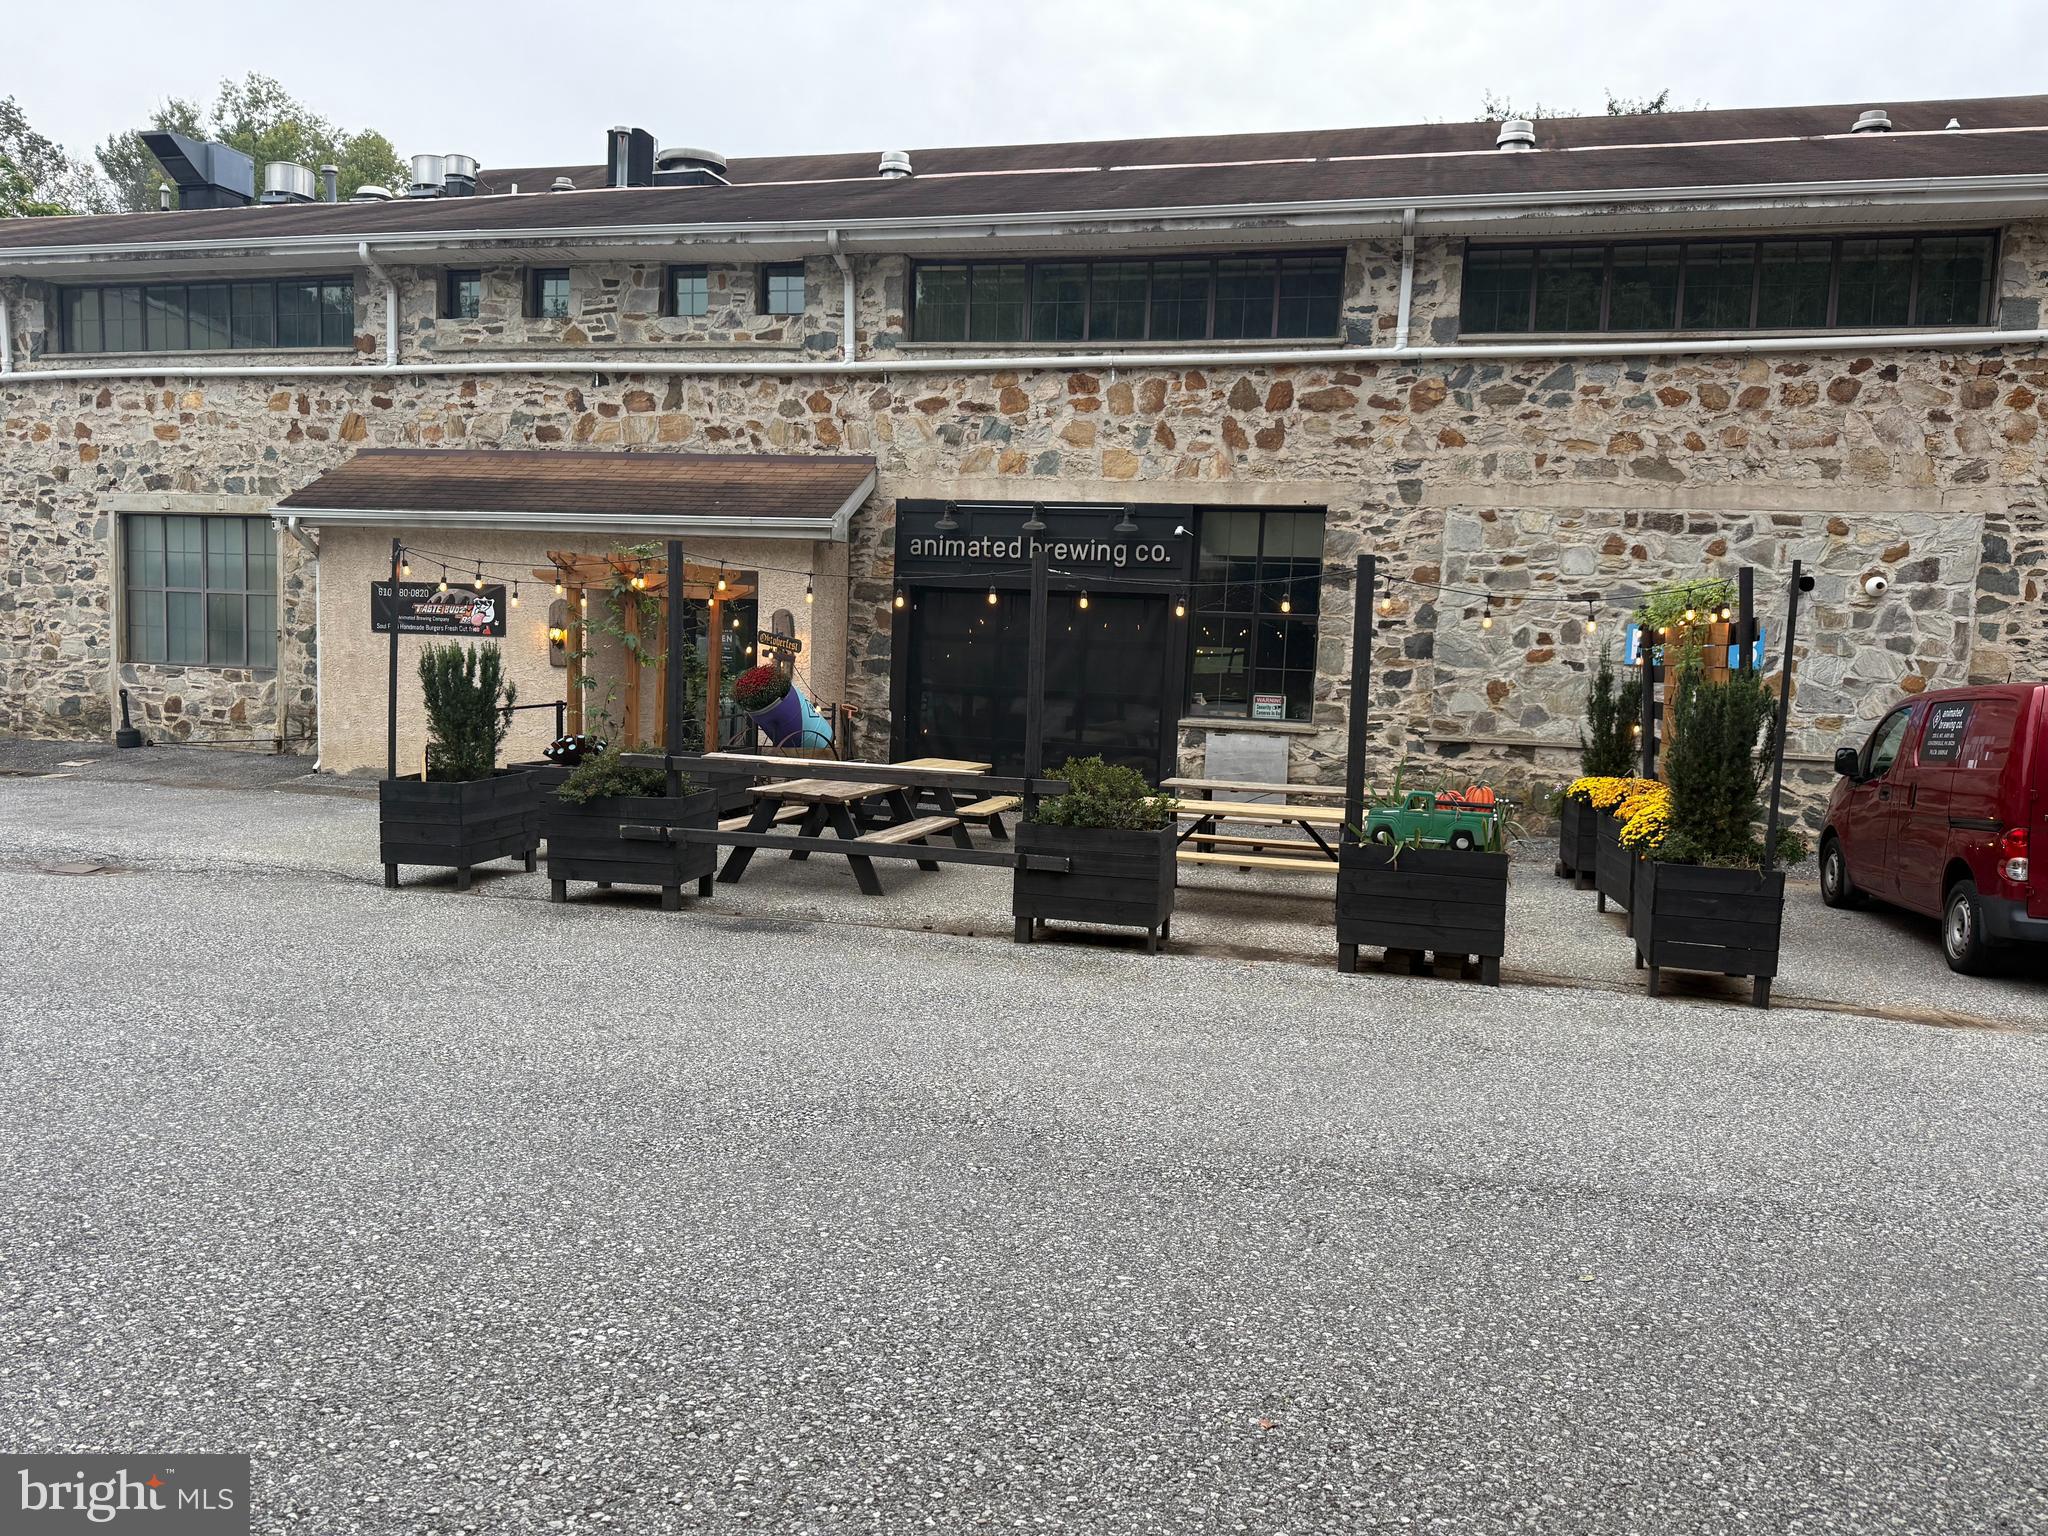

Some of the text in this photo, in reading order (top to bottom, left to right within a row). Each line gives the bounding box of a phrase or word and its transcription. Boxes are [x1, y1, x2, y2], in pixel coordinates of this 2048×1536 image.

[909, 534, 1171, 567] animated brewing co.
[415, 603, 443, 614] TASTE
[399, 623, 425, 631] Handmade
[425, 624, 444, 632] Burgers
[759, 633, 798, 650] Oktoberfest
[1942, 707, 1965, 718] animated
[1938, 719, 1955, 731] brewing
